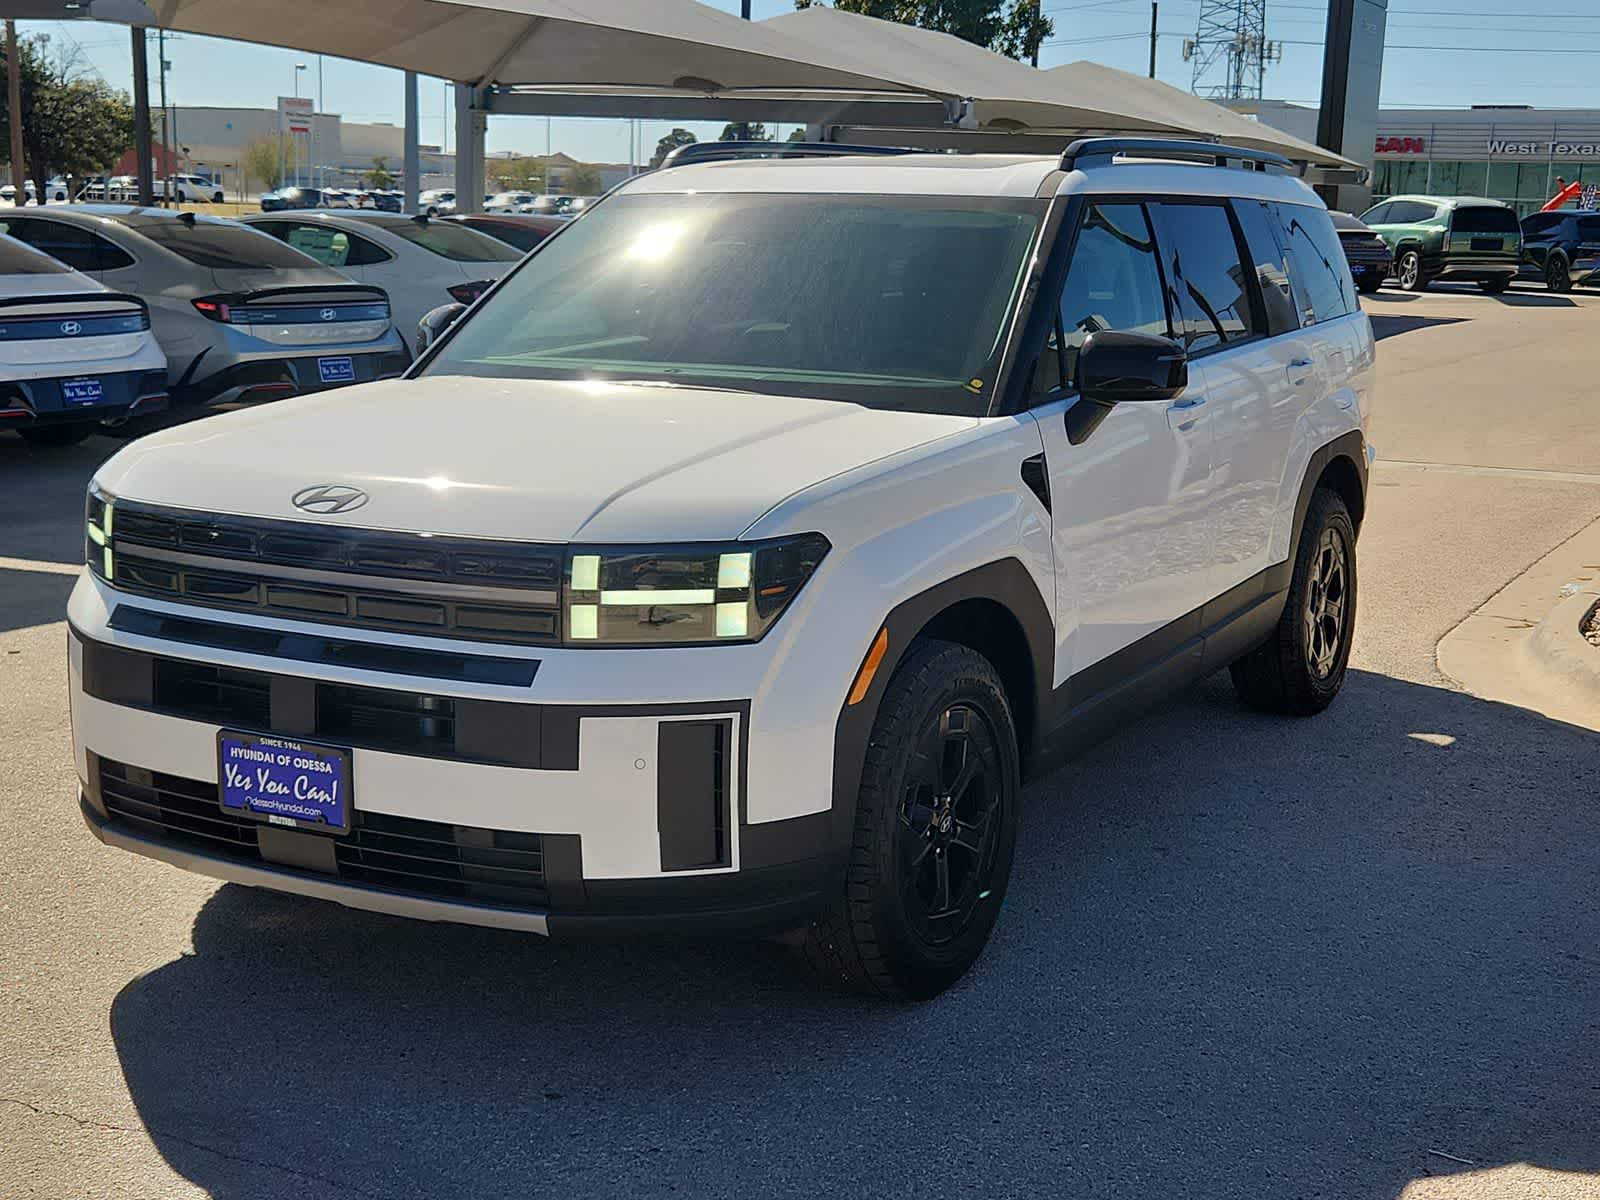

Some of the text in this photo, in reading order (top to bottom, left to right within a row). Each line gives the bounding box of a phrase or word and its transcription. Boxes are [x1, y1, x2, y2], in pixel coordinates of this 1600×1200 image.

[1487, 140, 1537, 155] West
[260, 737, 283, 748] SINCE
[230, 747, 333, 774] HYUNDAI OF ODESSA
[225, 763, 338, 805] Yes You Can!
